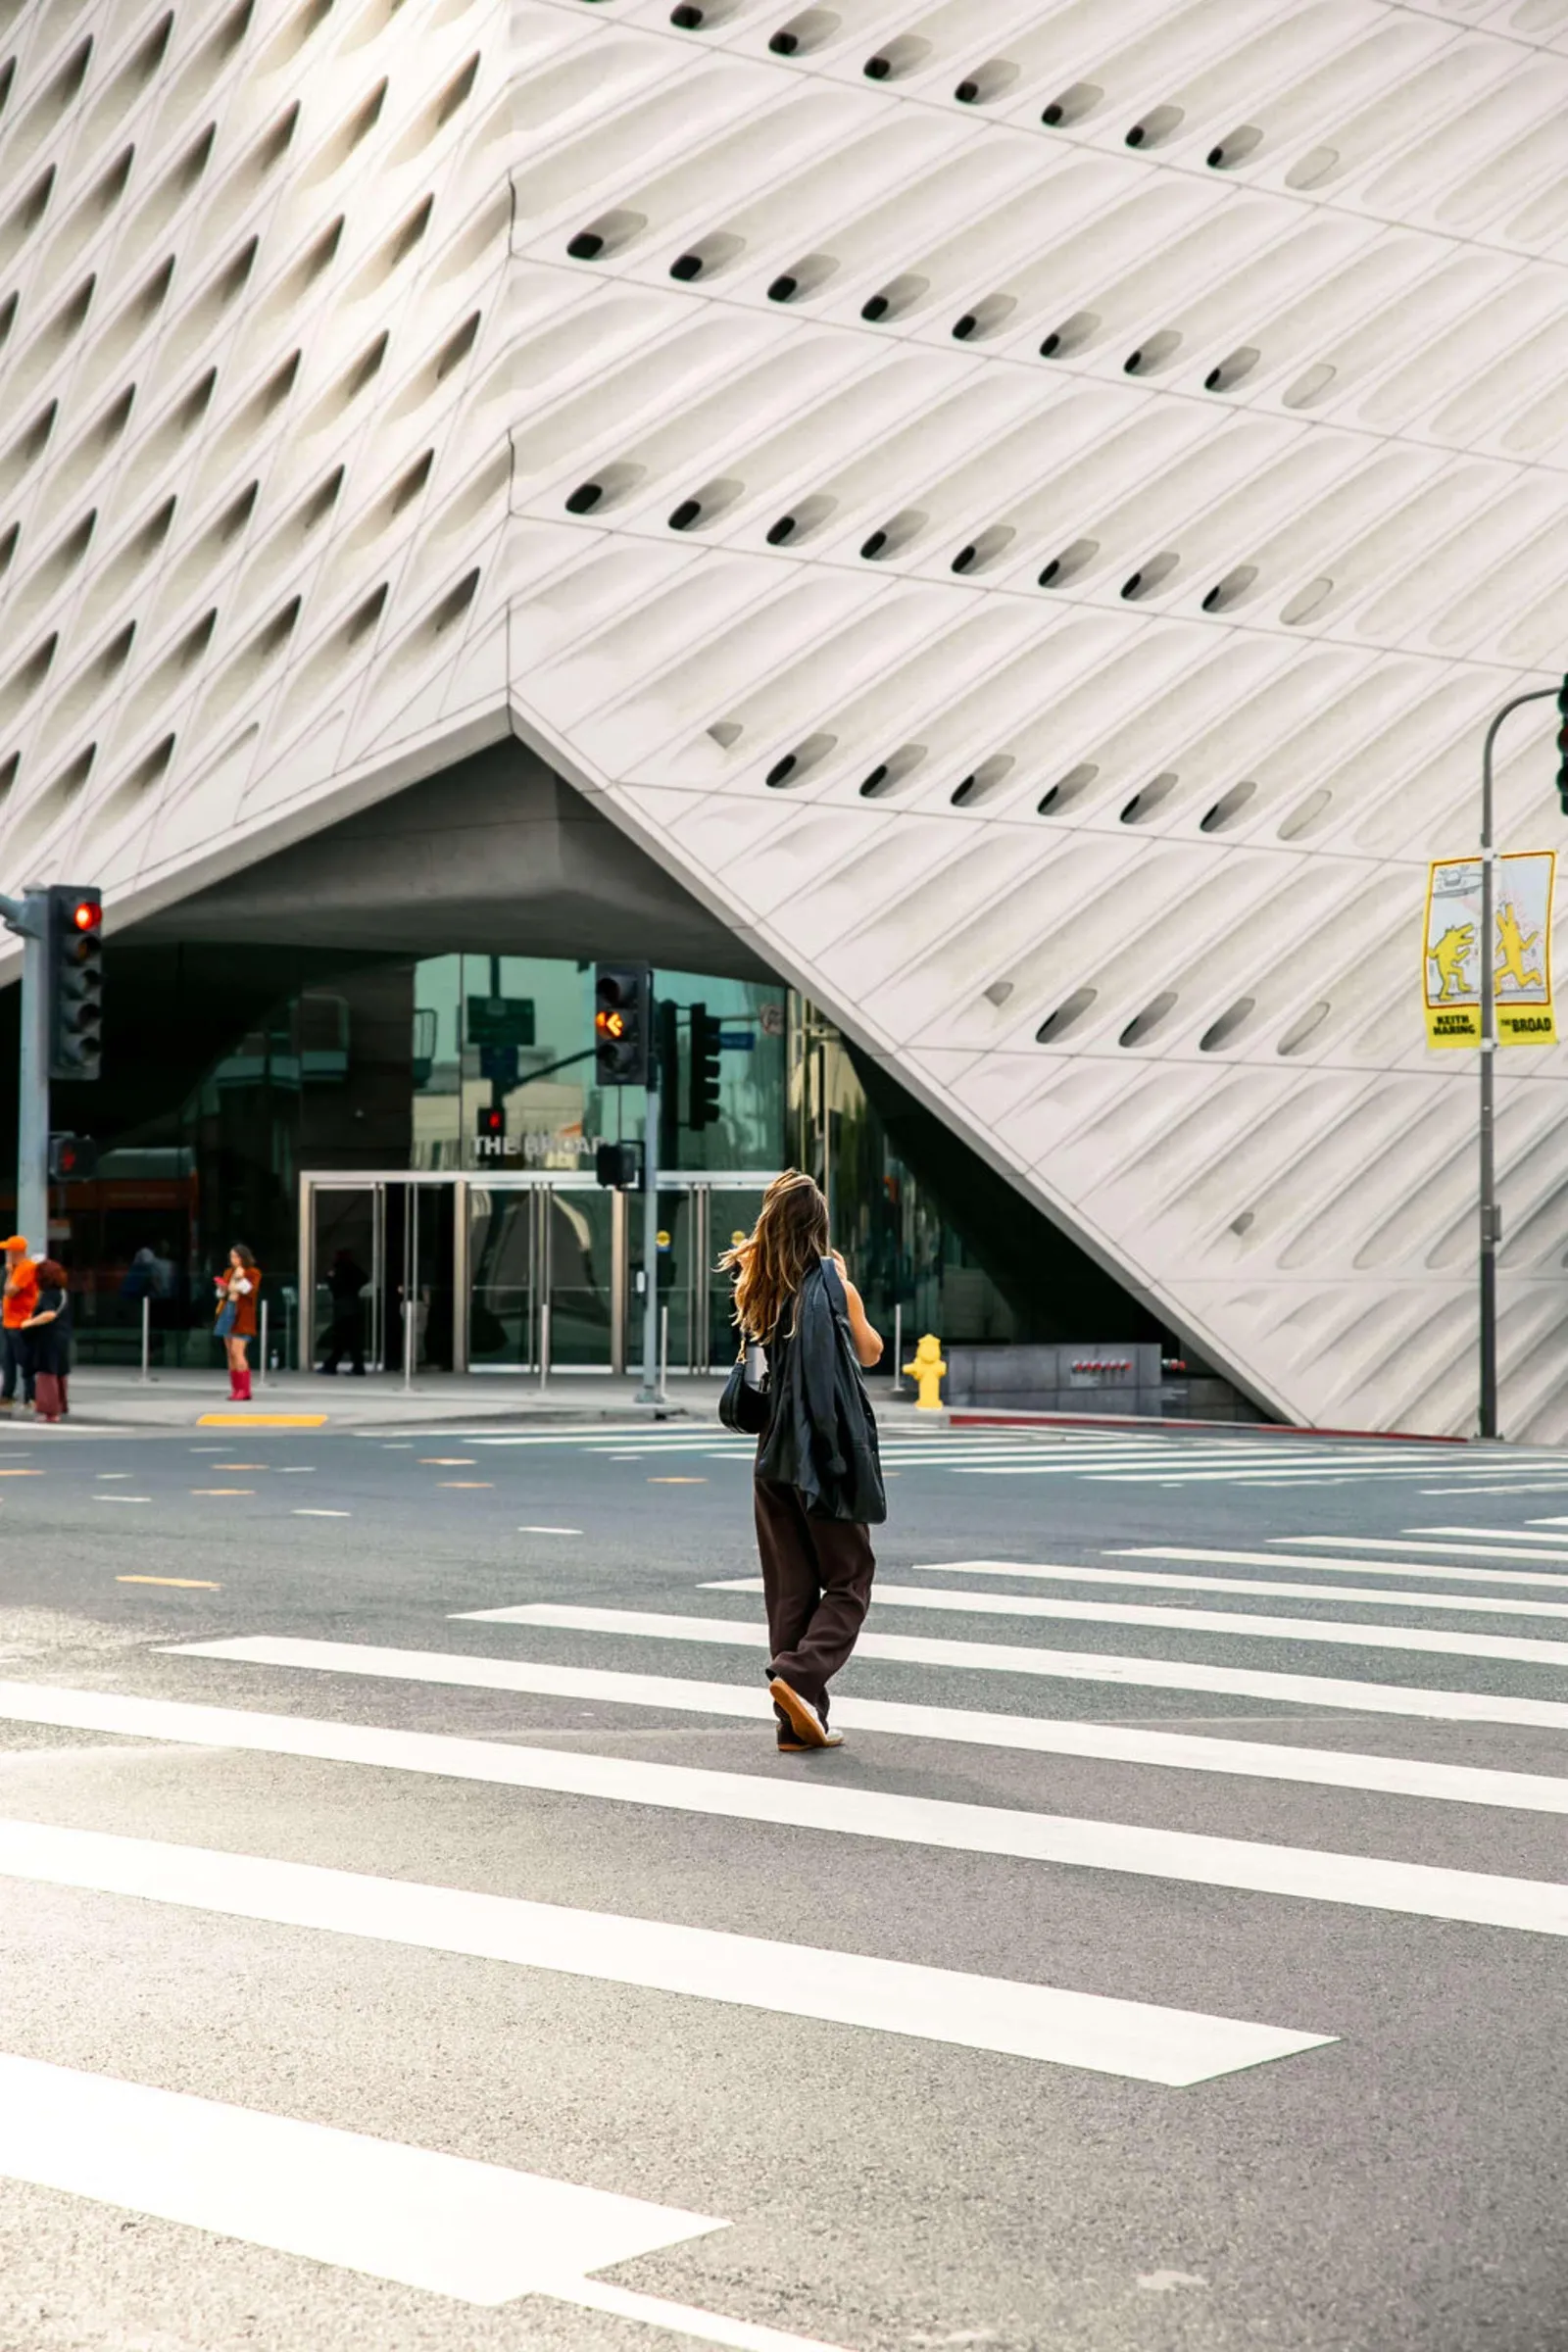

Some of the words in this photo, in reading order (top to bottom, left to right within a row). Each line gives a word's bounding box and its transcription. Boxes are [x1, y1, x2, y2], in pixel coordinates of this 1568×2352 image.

[1437, 1015, 1469, 1024] KEITH
[1512, 1017, 1551, 1032] BROAD
[1433, 1024, 1475, 1035] HARING
[473, 1136, 516, 1155] THE
